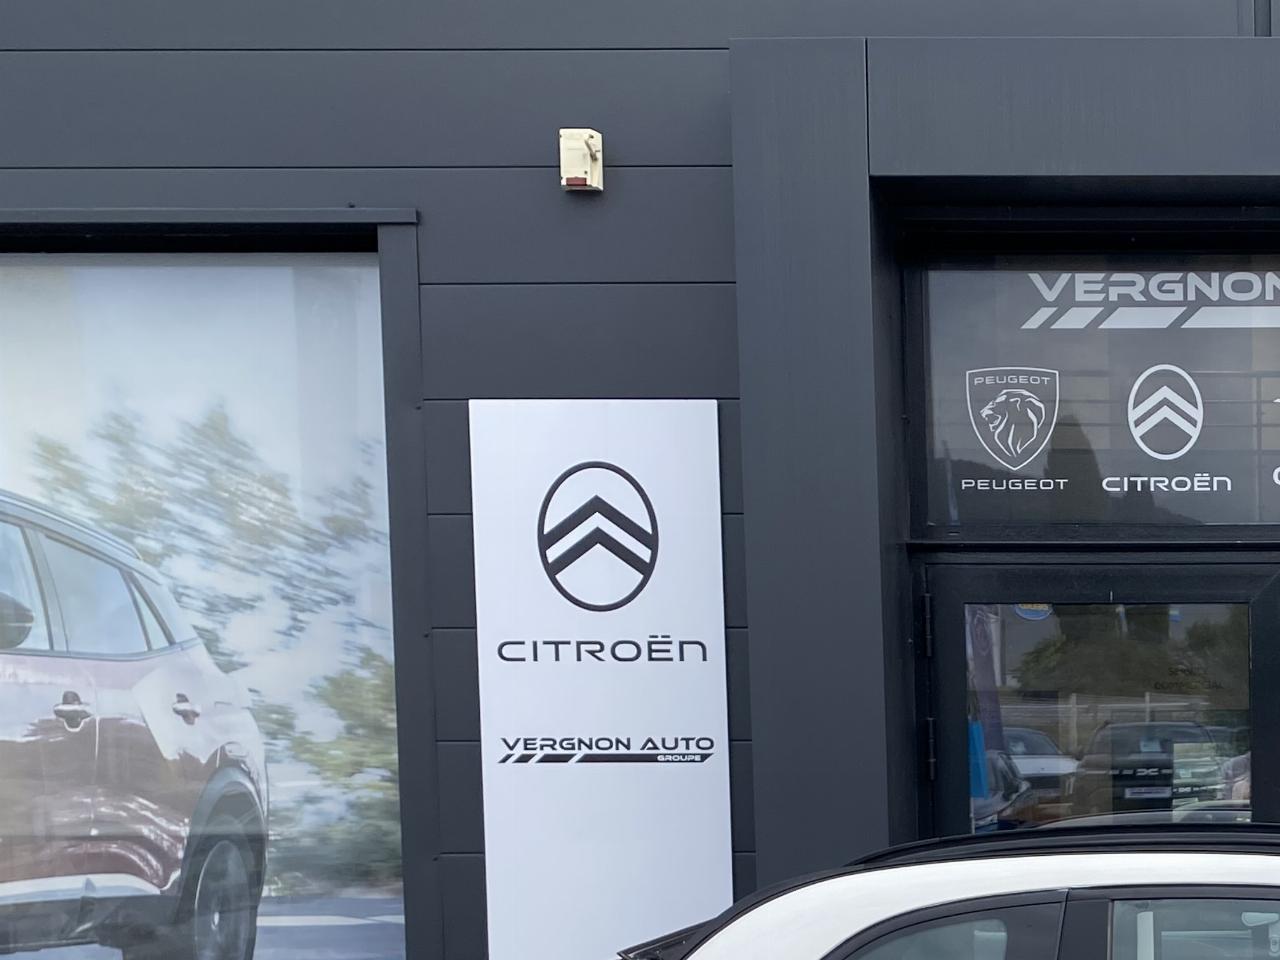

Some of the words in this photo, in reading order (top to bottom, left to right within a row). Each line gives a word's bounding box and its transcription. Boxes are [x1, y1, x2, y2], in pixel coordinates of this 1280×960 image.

[974, 375, 1051, 386] PEUGEOT
[961, 479, 1069, 490] PEUGEOT
[1102, 473, 1232, 492] CITROËN
[497, 634, 708, 662] CITROËN
[501, 737, 631, 751] VERGNON
[639, 737, 715, 751] AUTO
[656, 754, 702, 763] GROUPE
